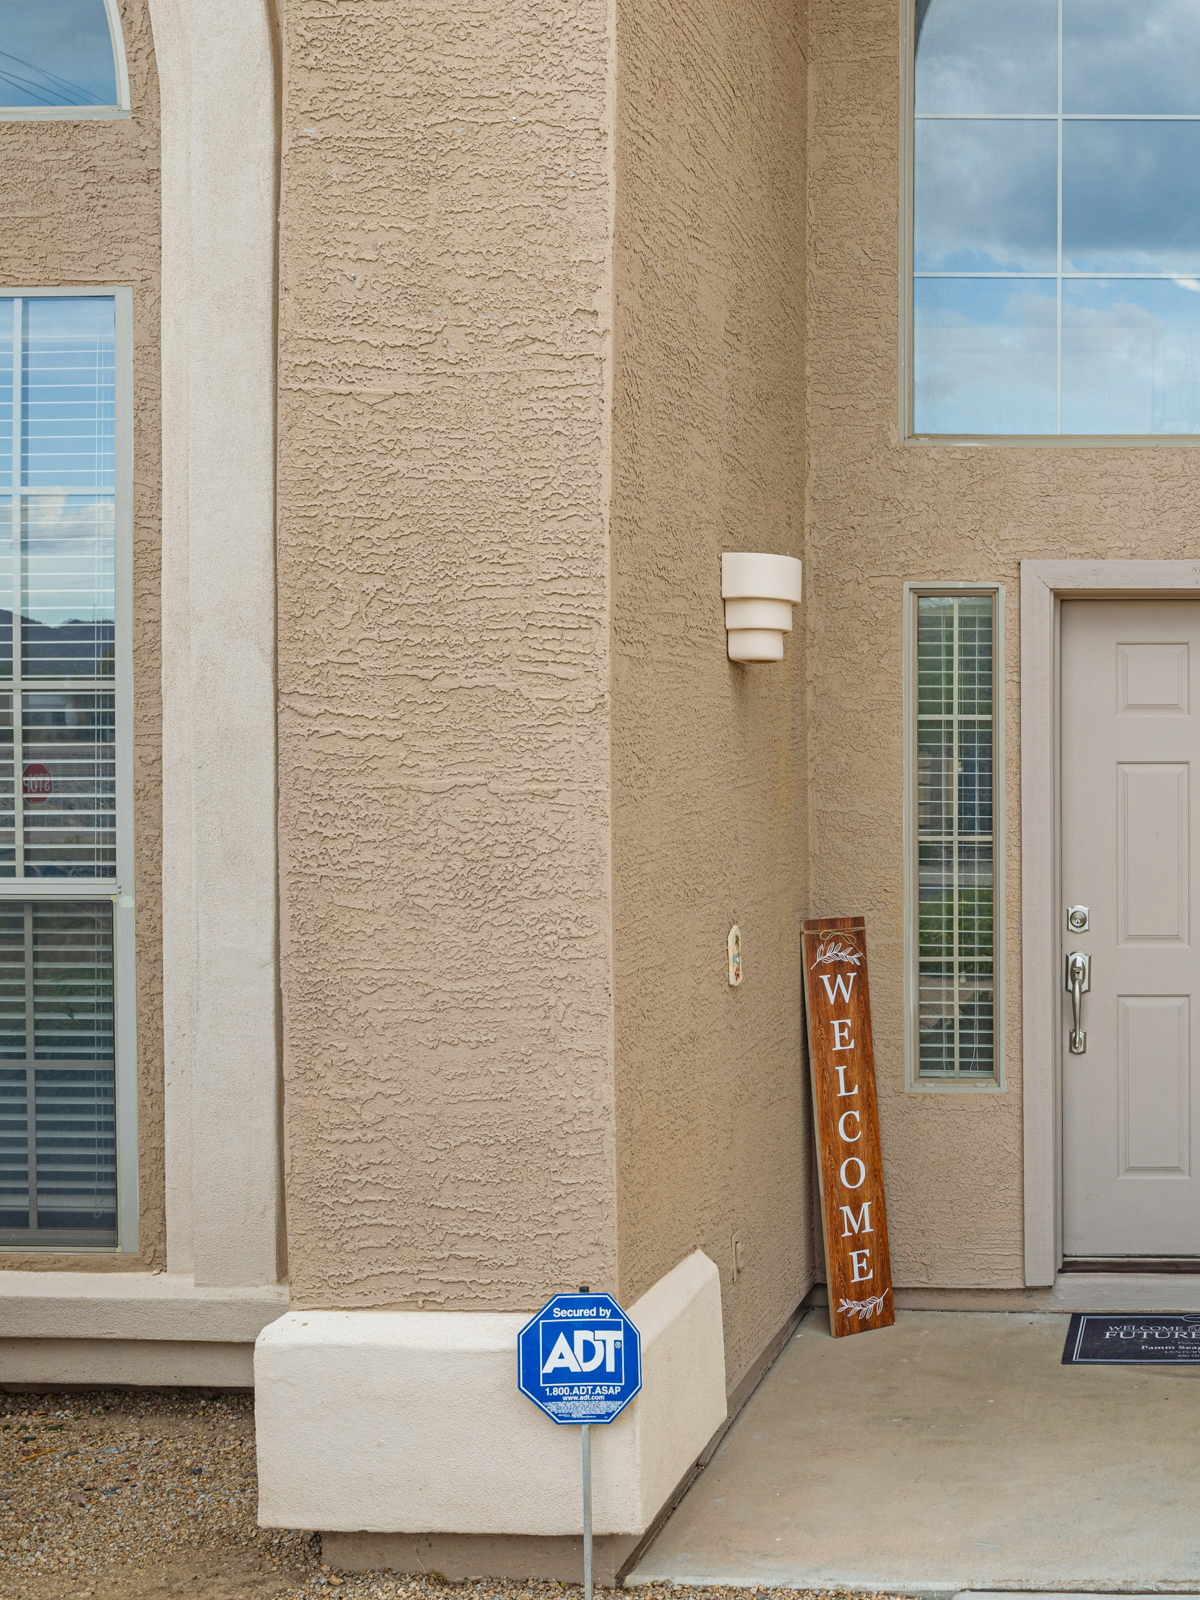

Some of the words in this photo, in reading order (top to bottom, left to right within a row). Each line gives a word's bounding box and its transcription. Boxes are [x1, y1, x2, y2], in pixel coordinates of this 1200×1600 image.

[820, 972, 874, 1283] WELCOME
[553, 1307, 596, 1318] Secured
[599, 1306, 611, 1319] by
[542, 1330, 622, 1373] ADT
[545, 1386, 621, 1396] 1.800.ADT.ASAP
